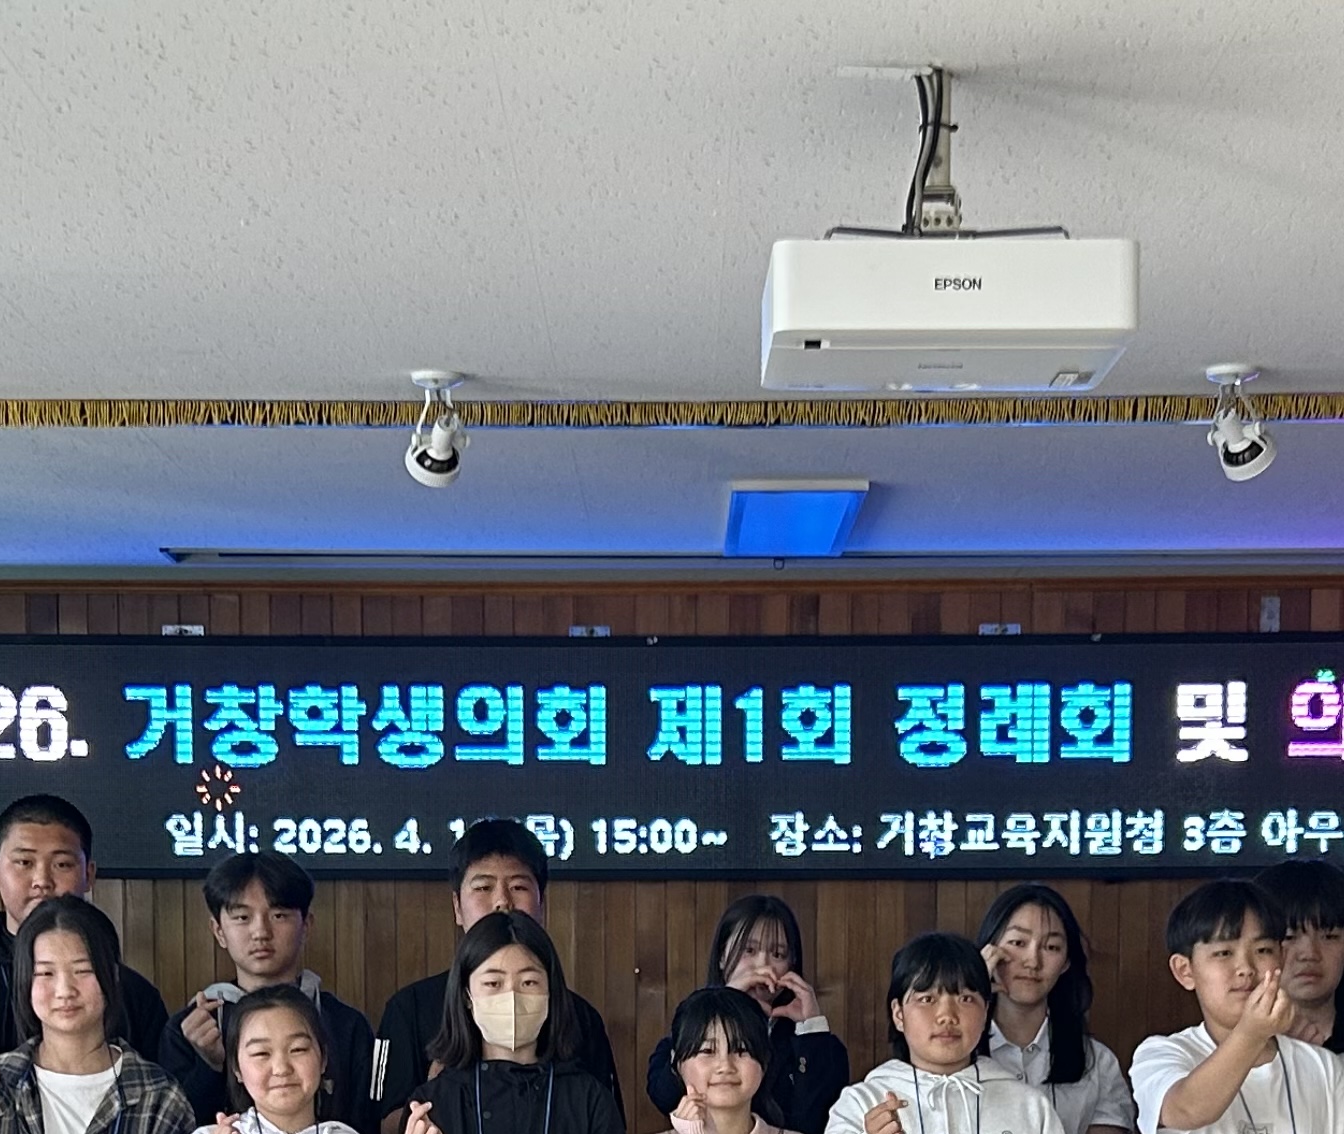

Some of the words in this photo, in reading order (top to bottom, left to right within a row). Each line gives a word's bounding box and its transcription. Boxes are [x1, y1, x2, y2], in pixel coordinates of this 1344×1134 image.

[934, 278, 982, 291] EPSON
[122, 682, 608, 770] 거창학생의회
[645, 682, 853, 766] 제1회
[892, 680, 1134, 767] 정례회
[1174, 680, 1250, 763] 및
[165, 810, 260, 856] 일시:
[273, 817, 384, 855] 2026.
[393, 817, 433, 855] 4.
[590, 818, 729, 855] 15:00~
[768, 810, 864, 857] 장소:
[875, 808, 1165, 859] 거창교육지원청
[1182, 809, 1248, 855] 3층
